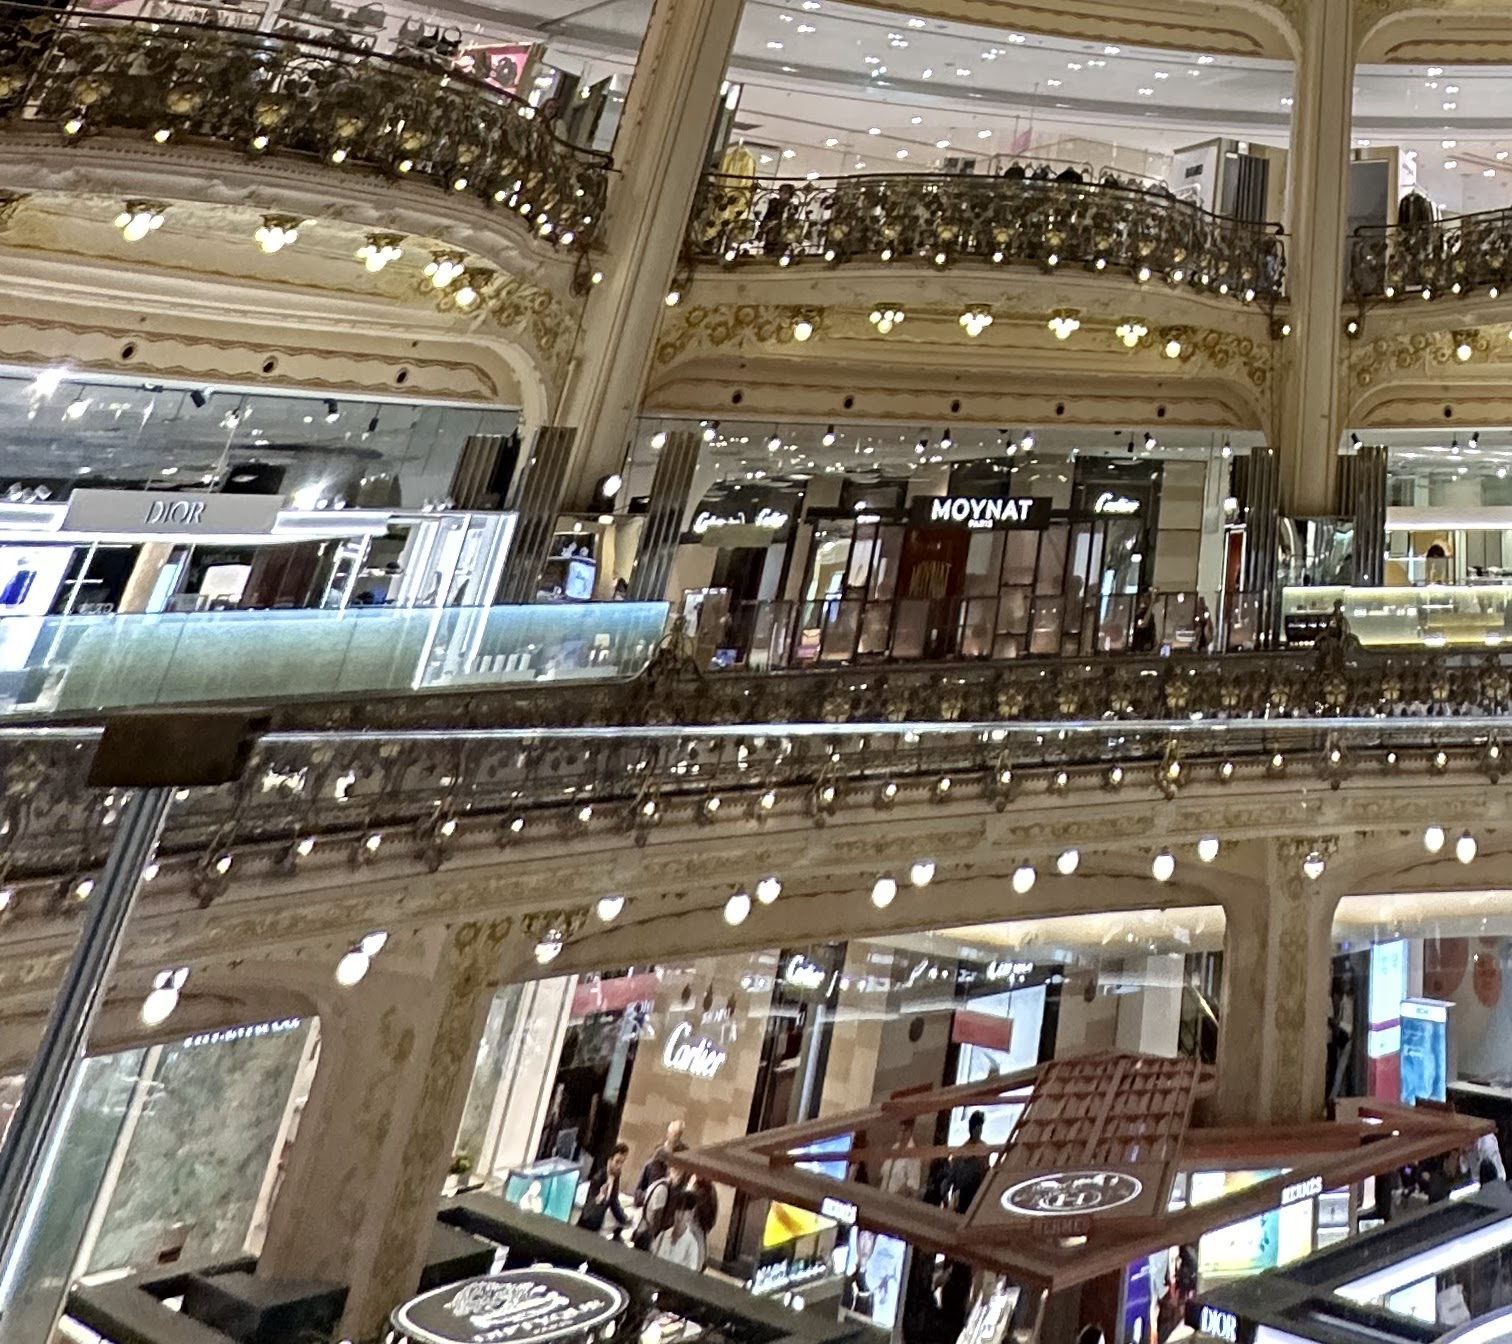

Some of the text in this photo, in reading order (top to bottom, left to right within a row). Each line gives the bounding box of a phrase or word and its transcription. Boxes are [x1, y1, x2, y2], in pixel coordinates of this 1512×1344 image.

[145, 500, 207, 524] DIOR
[931, 498, 1033, 521] MOYNAT
[663, 1021, 726, 1081] Cartier
[1200, 1305, 1237, 1343] DIOR
